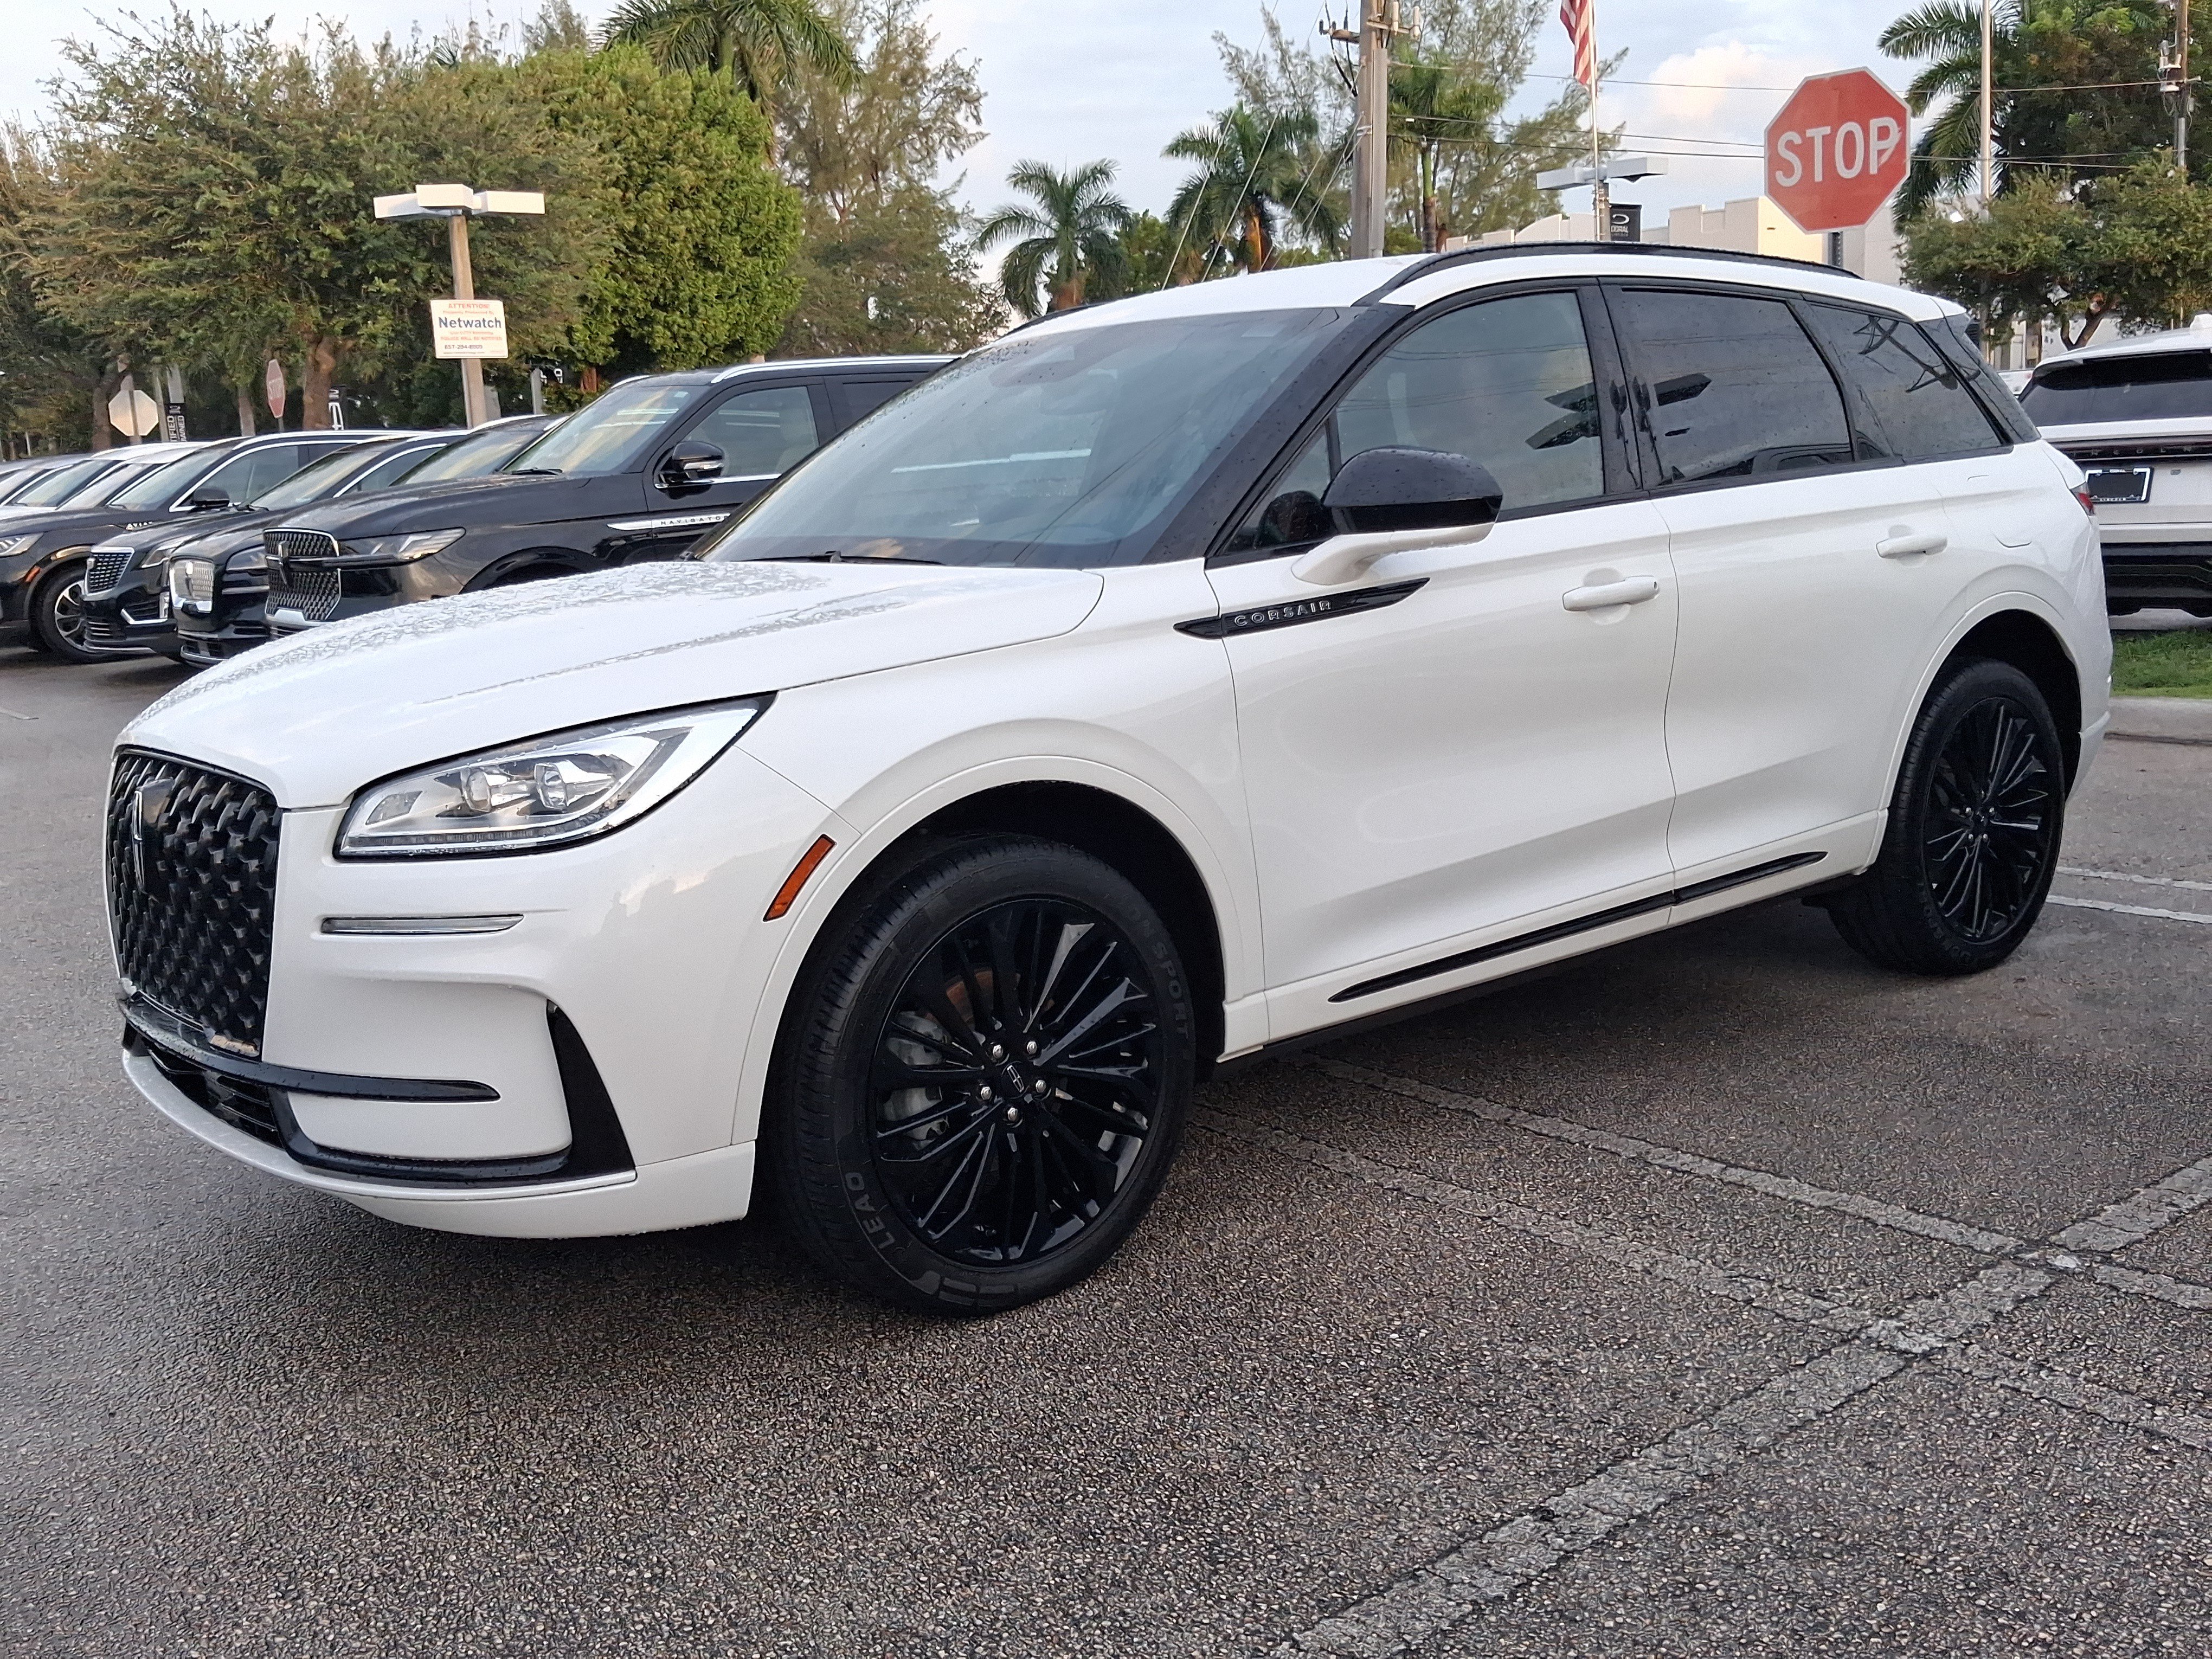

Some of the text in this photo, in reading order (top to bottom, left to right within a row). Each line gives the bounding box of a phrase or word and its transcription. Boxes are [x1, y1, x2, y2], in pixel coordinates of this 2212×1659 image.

[1776, 117, 1902, 187] STOP
[438, 317, 501, 328] Netwatch
[1234, 600, 1331, 626] CORSAIR
[1152, 941, 1189, 1039] SPORT
[845, 1172, 895, 1249] LEAO
